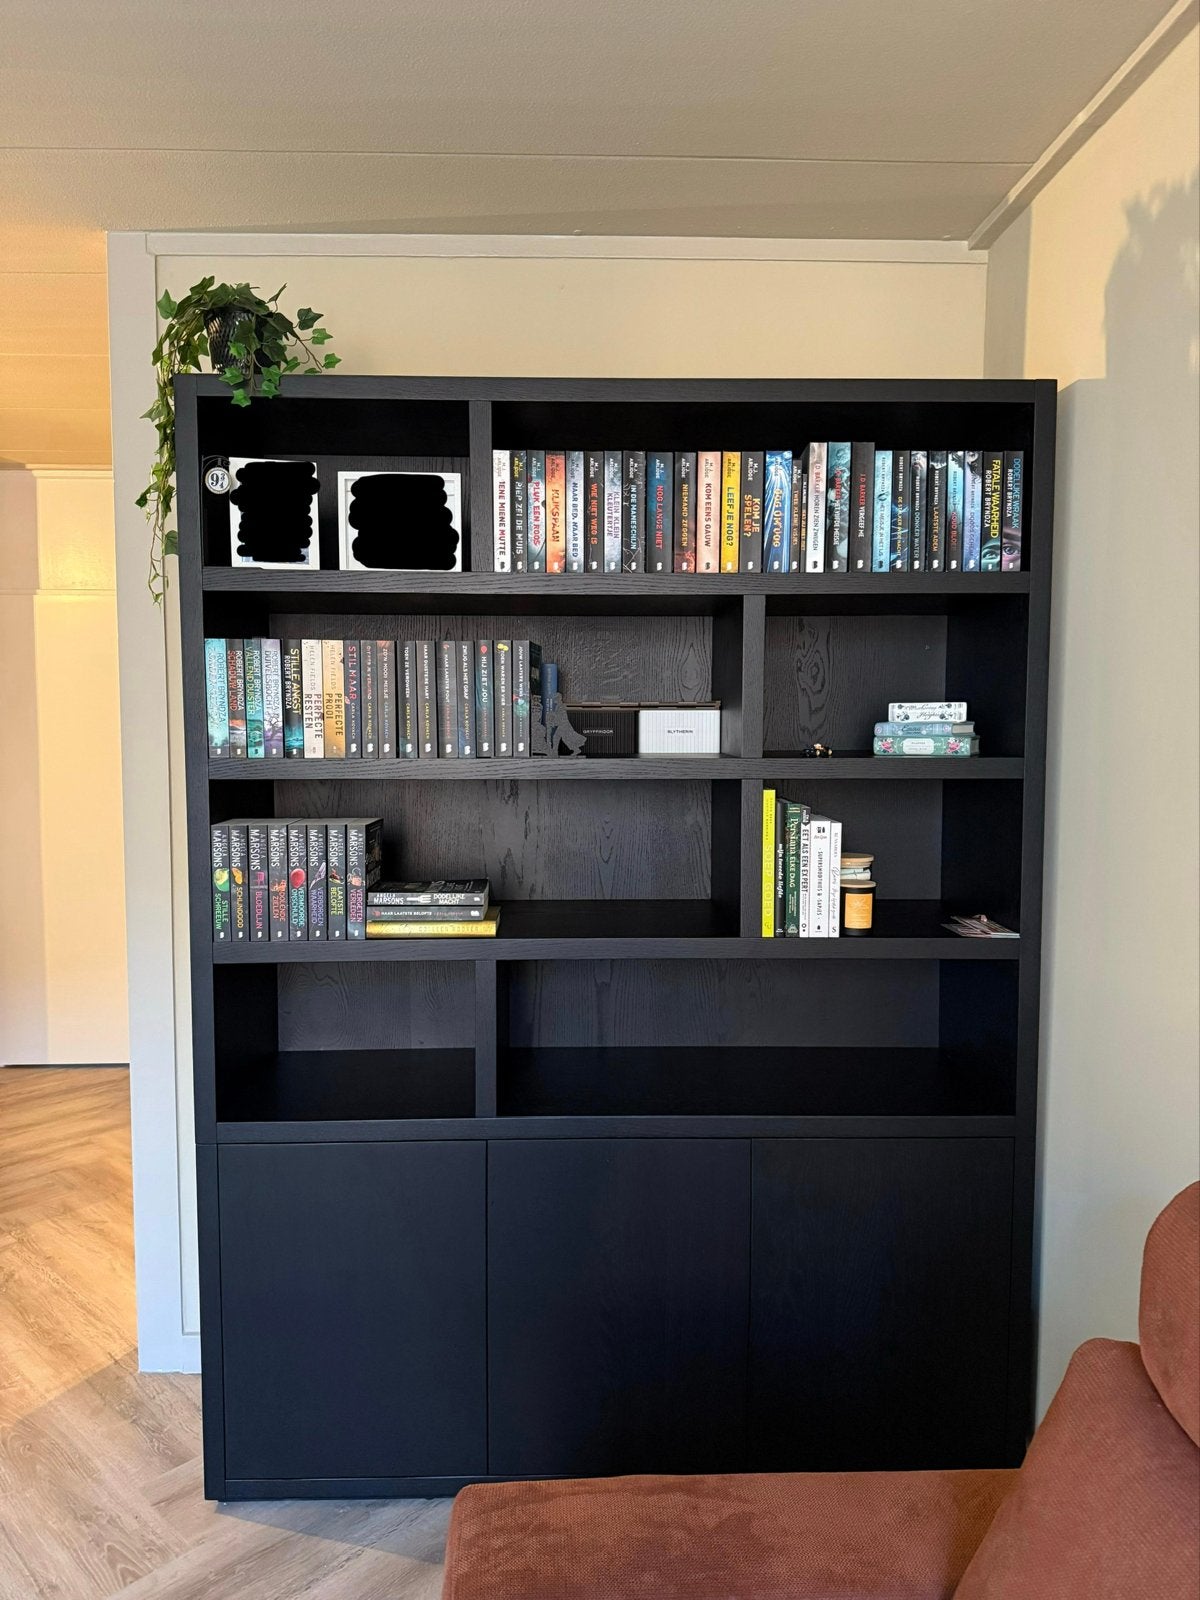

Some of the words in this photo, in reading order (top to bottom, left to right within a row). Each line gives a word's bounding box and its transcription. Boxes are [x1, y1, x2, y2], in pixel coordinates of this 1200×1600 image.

[992, 460, 1000, 490] FATALE
[631, 494, 636, 503] DE
[727, 509, 734, 520] JE
[752, 498, 760, 519] KOM
[773, 489, 782, 508] OOG
[991, 492, 999, 538] WAARHEID
[1012, 500, 1020, 528] WRAAK
[515, 520, 522, 531] DE
[752, 522, 760, 532] JE
[217, 653, 225, 684] ROBERT
[246, 647, 254, 682] VALLEND
[290, 648, 300, 681] STILLE
[348, 646, 357, 668] STIL
[264, 650, 273, 710] DUIVELSBOCHT
[272, 679, 280, 710] BRYNDZA
[349, 670, 357, 700] MAAR
[218, 686, 226, 723] BRYNDZA
[247, 684, 255, 715] DUISTER
[292, 683, 301, 715] ANGST
[325, 693, 333, 719] PROOI
[335, 693, 343, 736] PERFECTE
[314, 694, 322, 739] PERFECTE
[213, 830, 222, 867] MARSONS
[231, 830, 240, 867] MARSONS
[250, 830, 260, 870] MARSONS
[270, 830, 280, 867] MARSONS
[290, 830, 299, 867] MARSONS
[310, 830, 318, 866] MARSONS
[329, 830, 338, 866] MARSONS
[349, 830, 358, 866] MARSONS
[789, 818, 798, 854] Persiana
[765, 844, 773, 876] SOEP
[765, 882, 773, 916] GOED
